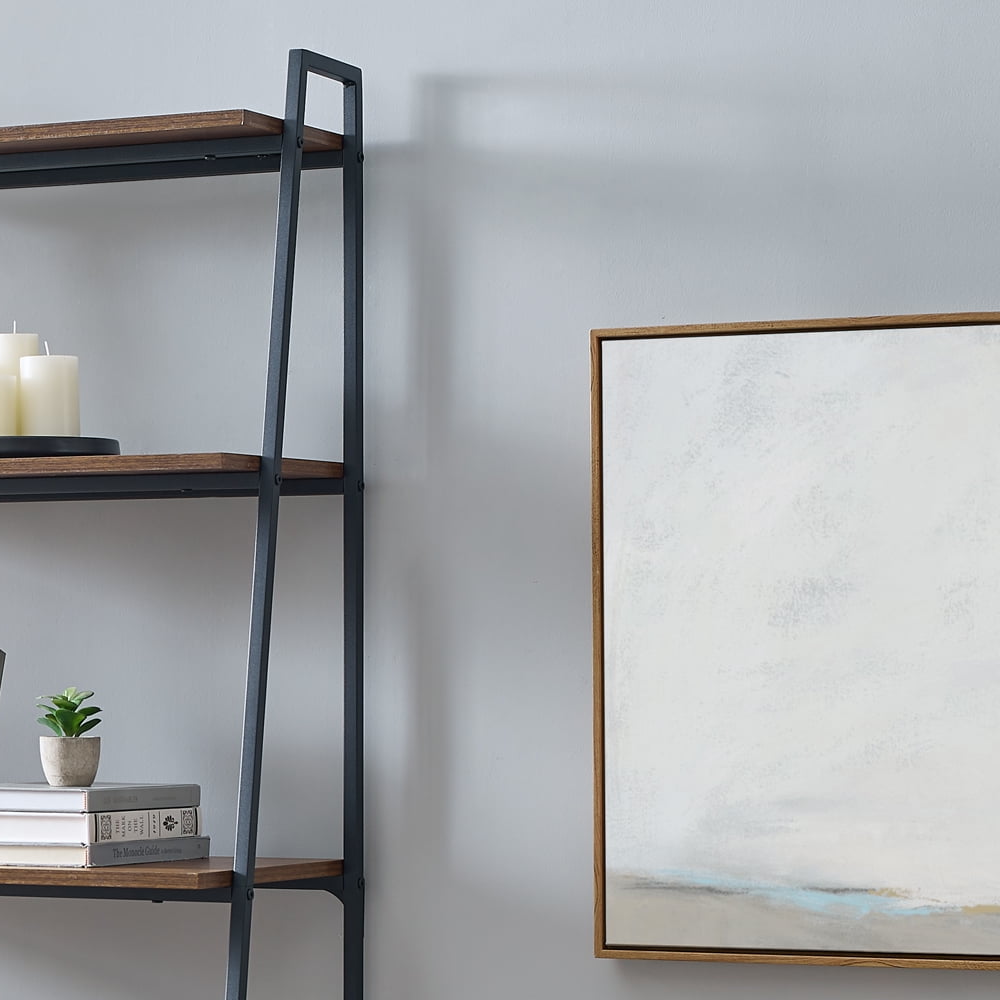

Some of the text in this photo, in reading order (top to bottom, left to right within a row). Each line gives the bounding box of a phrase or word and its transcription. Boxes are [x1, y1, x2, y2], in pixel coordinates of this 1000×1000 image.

[112, 848, 123, 858] The
[123, 846, 144, 857] Monocle
[145, 844, 160, 856] Guide
